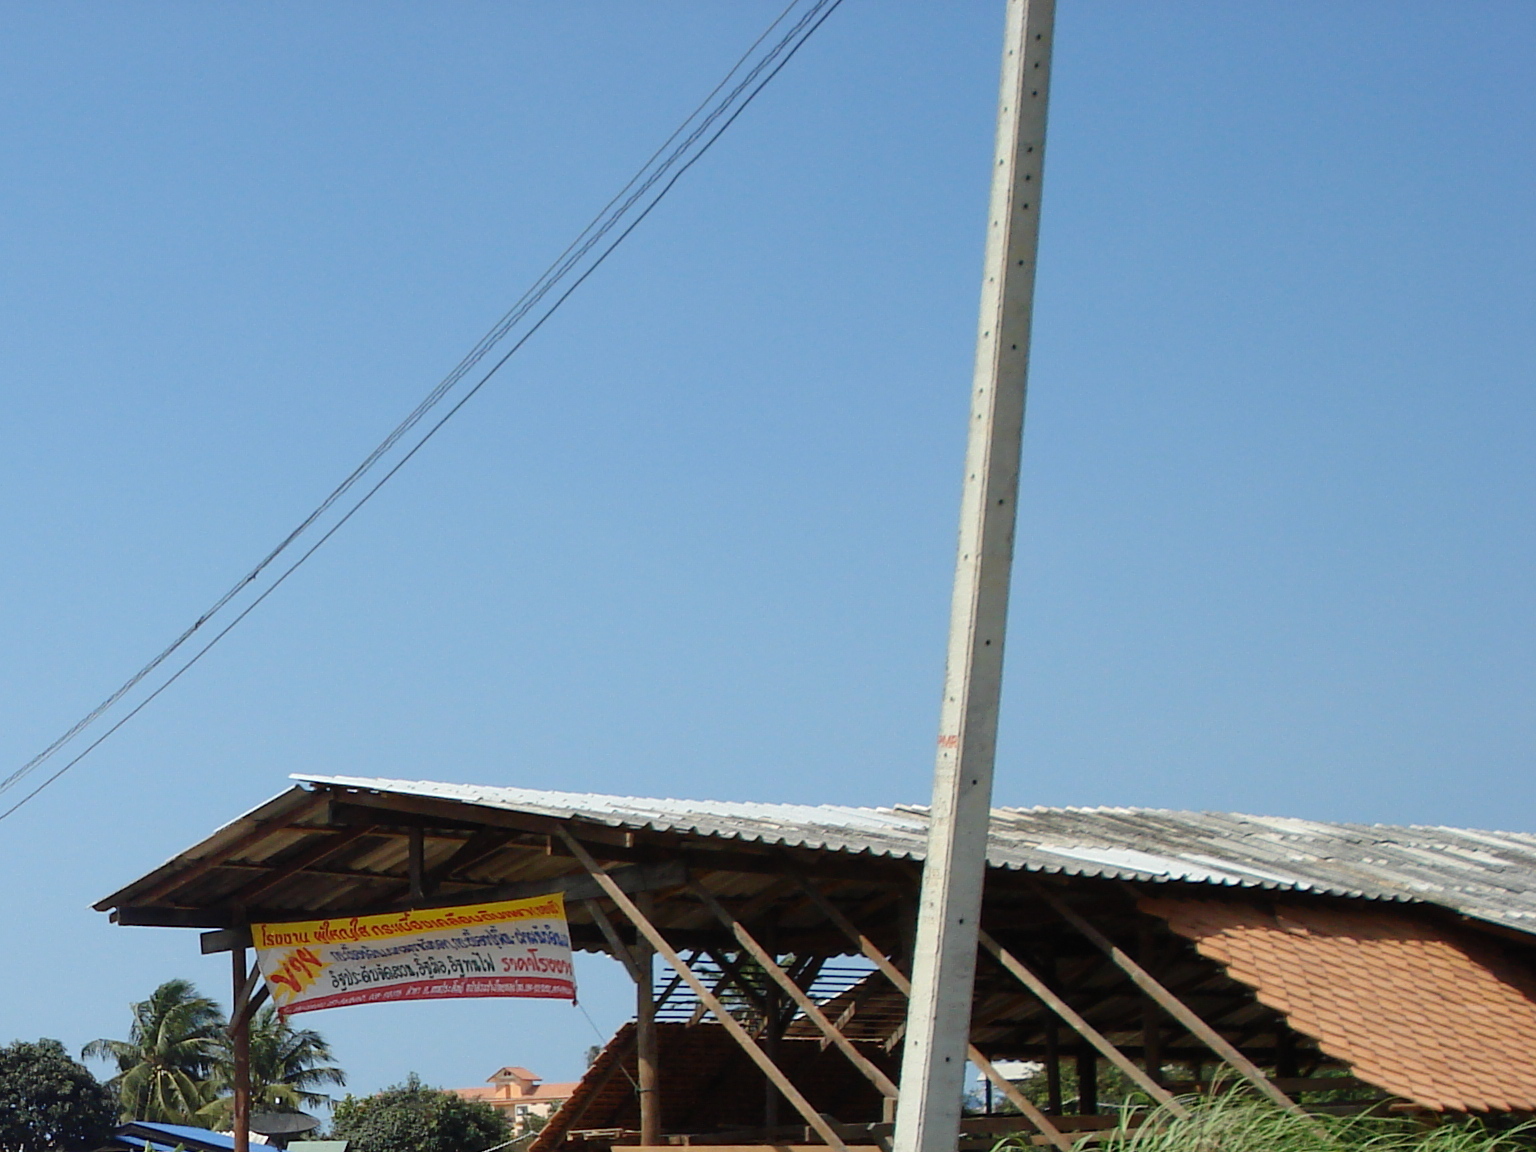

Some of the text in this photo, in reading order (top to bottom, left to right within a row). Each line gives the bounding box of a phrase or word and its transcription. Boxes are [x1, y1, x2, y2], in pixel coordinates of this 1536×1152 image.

[262, 923, 310, 946] โรงงาน
[270, 946, 323, 993] ขาย
